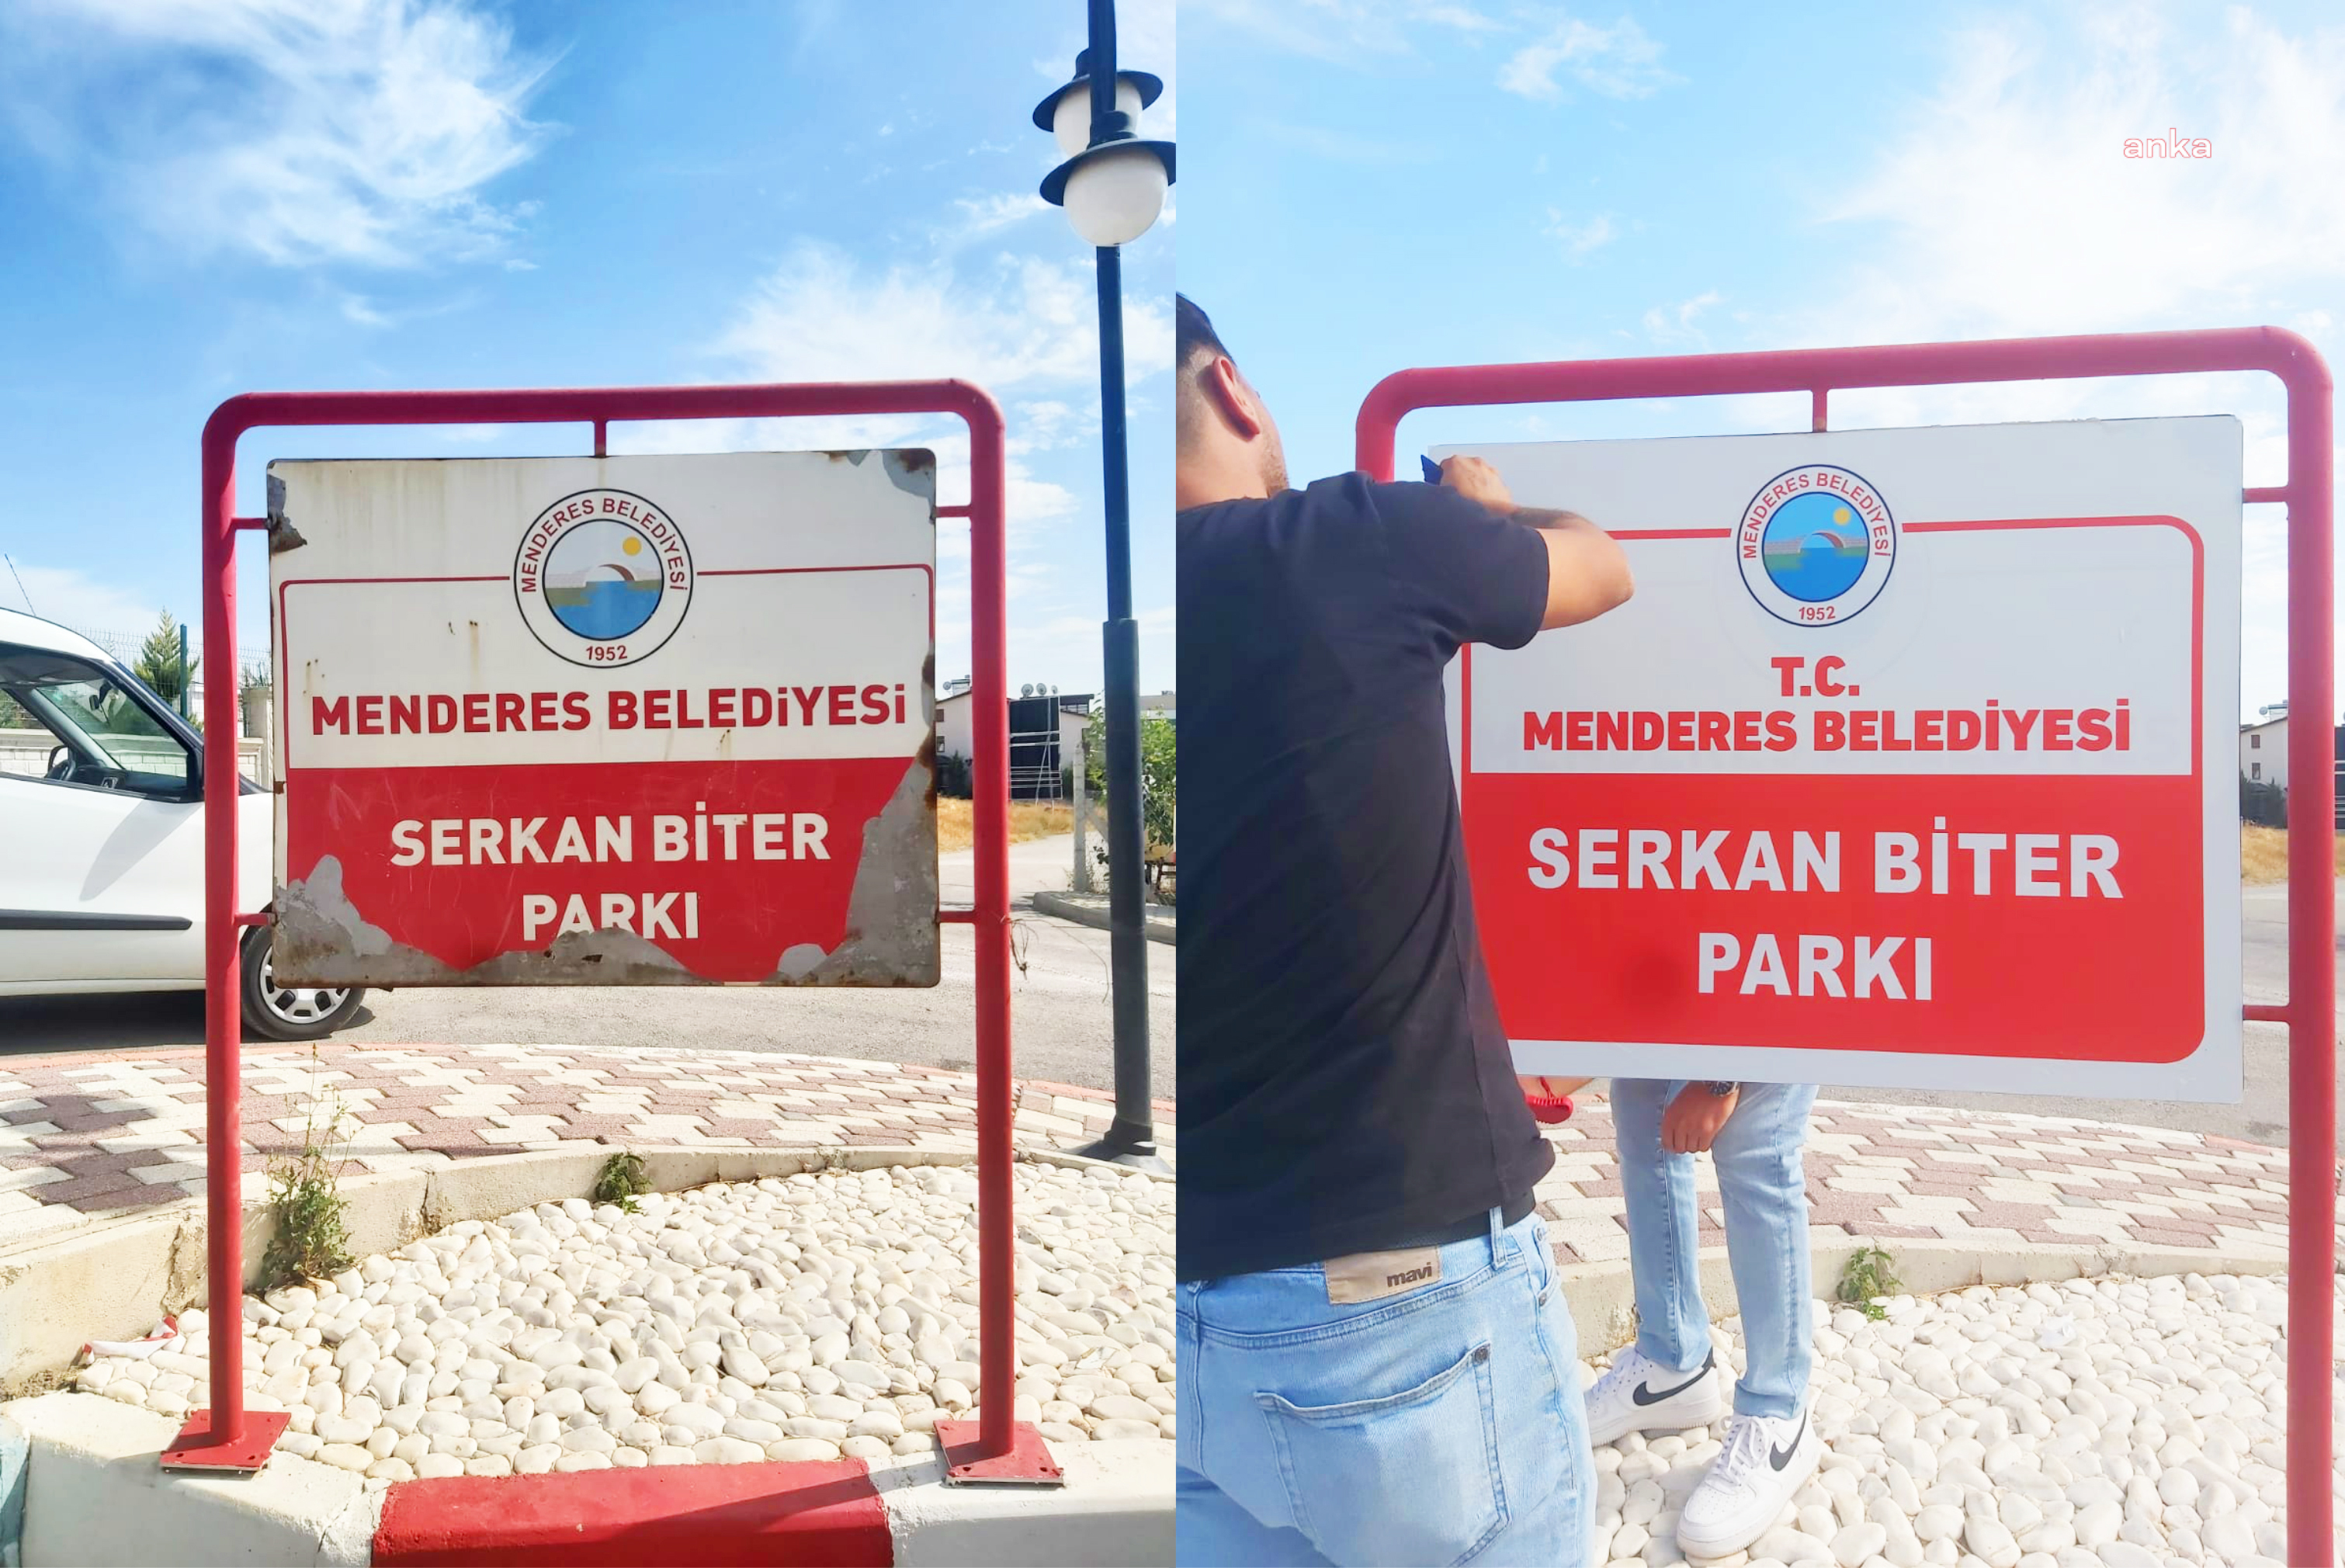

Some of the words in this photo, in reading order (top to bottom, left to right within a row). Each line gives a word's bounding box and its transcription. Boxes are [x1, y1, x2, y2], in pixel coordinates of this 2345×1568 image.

[1743, 474, 1809, 559] MENDERES
[1816, 473, 1891, 557] BELEDİYESİ
[522, 499, 595, 592] MENDERES
[602, 498, 688, 590] BELEDİYESİ
[1799, 605, 1836, 620] 1952
[586, 645, 628, 661] 1952
[1771, 655, 1861, 697] T.C.
[312, 691, 591, 736] MENDERES
[1523, 709, 1797, 752] MENDERES
[1813, 698, 2130, 752] BELEDİYESİ
[390, 816, 632, 866] SERKAN
[654, 801, 831, 862] BİTER
[1528, 827, 1840, 893] SERKAN
[1875, 816, 2124, 899] BİTER
[522, 892, 699, 941] PARKI
[1698, 932, 1932, 1001] PARKI
[1387, 1261, 1433, 1288] mavi
